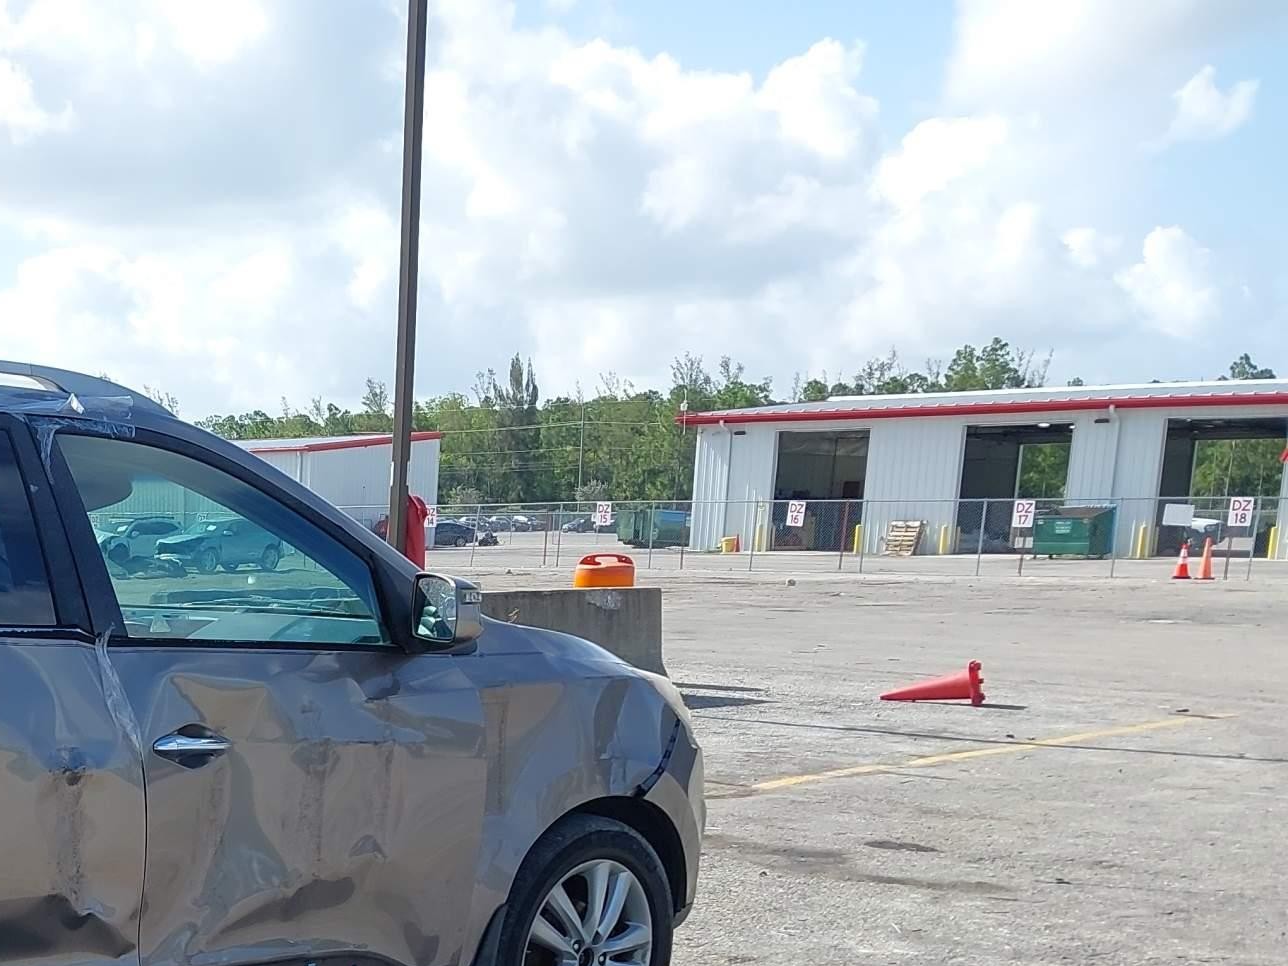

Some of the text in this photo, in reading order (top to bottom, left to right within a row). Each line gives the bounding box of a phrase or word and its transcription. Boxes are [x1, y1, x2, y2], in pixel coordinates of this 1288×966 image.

[598, 503, 610, 513] DZ
[790, 503, 804, 513] DZ
[1016, 502, 1033, 513] DZ
[1232, 499, 1252, 511] DZ
[427, 517, 434, 526] 14
[599, 514, 608, 523] 15
[790, 514, 800, 524] 16
[1018, 514, 1029, 525] 17
[1234, 513, 1247, 524] 18
